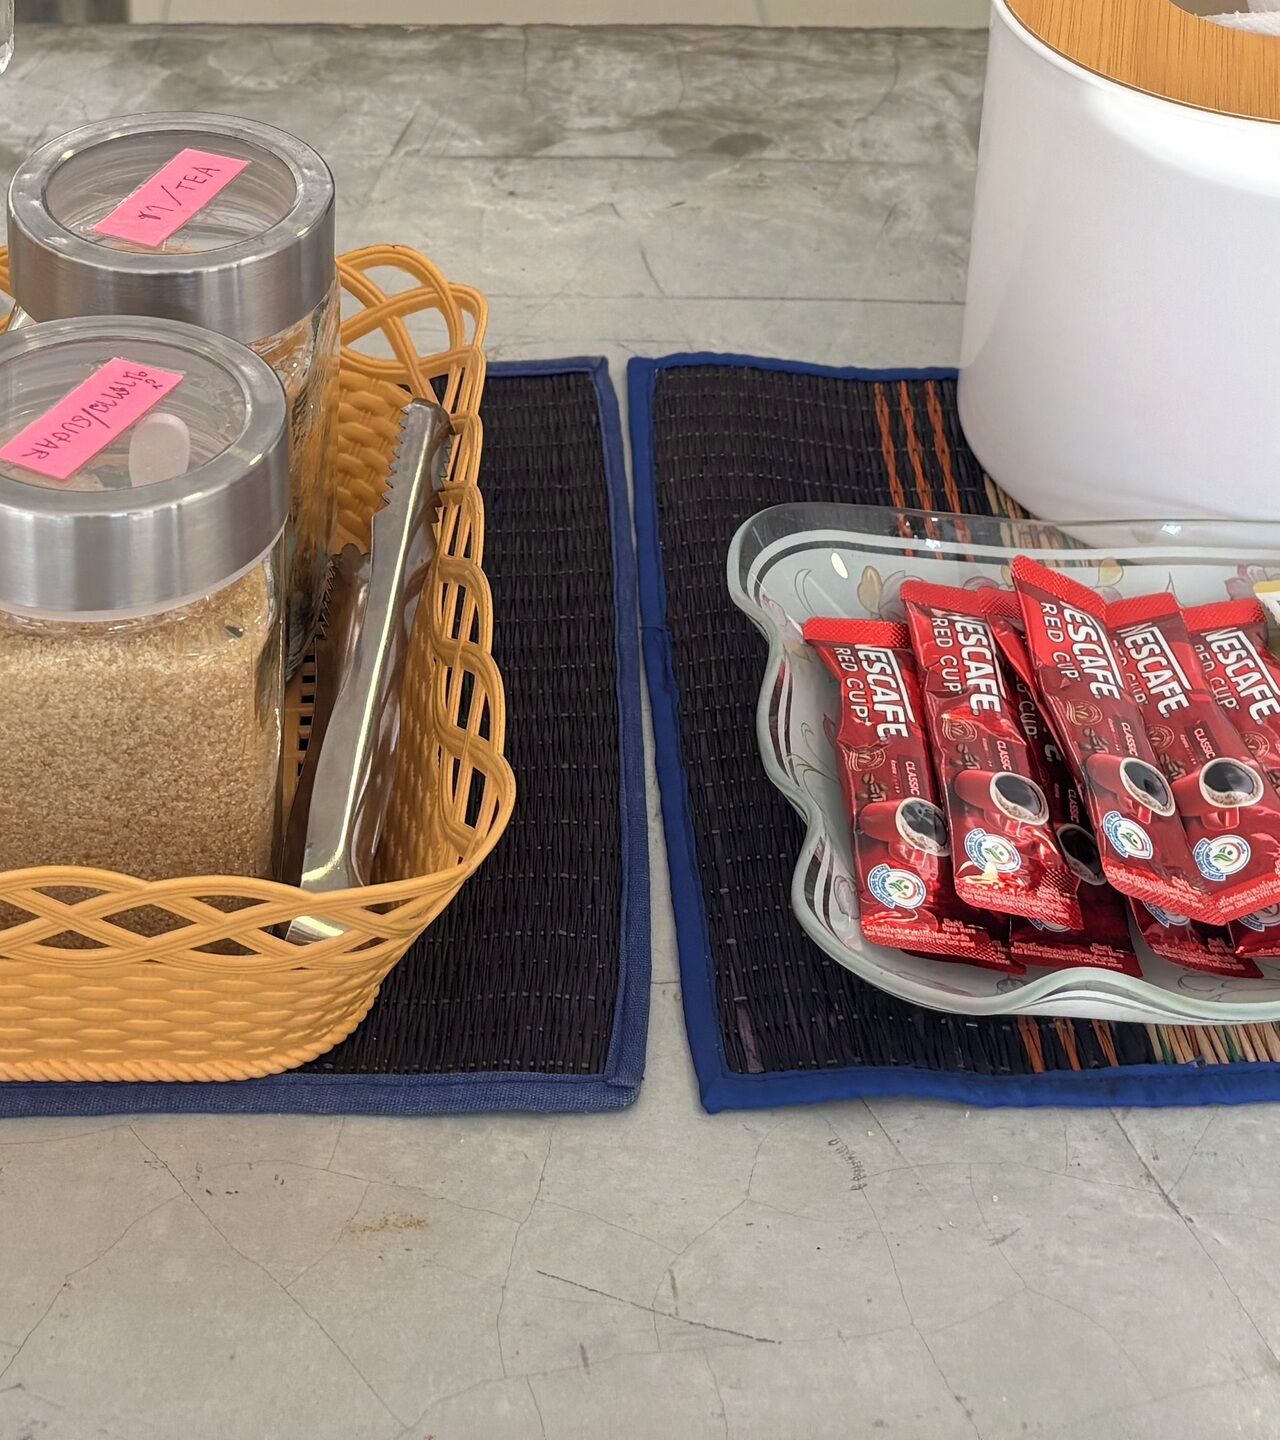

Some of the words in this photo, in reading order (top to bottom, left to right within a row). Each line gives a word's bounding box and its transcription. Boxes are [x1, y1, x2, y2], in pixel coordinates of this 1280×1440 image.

[930, 617, 953, 649] RED
[1039, 601, 1064, 643] RED
[1053, 649, 1079, 680] CUP
[833, 647, 859, 674] RED
[940, 654, 960, 693] CUP
[845, 677, 869, 719] CUP
[1208, 676, 1237, 711] CUP
[995, 740, 1013, 771] CLASSIC
[1120, 721, 1139, 757] CLASSIC
[1191, 726, 1216, 761] CLASSIC
[903, 760, 920, 796] CLASSIC
[1065, 788, 1080, 823] CLASSIC
